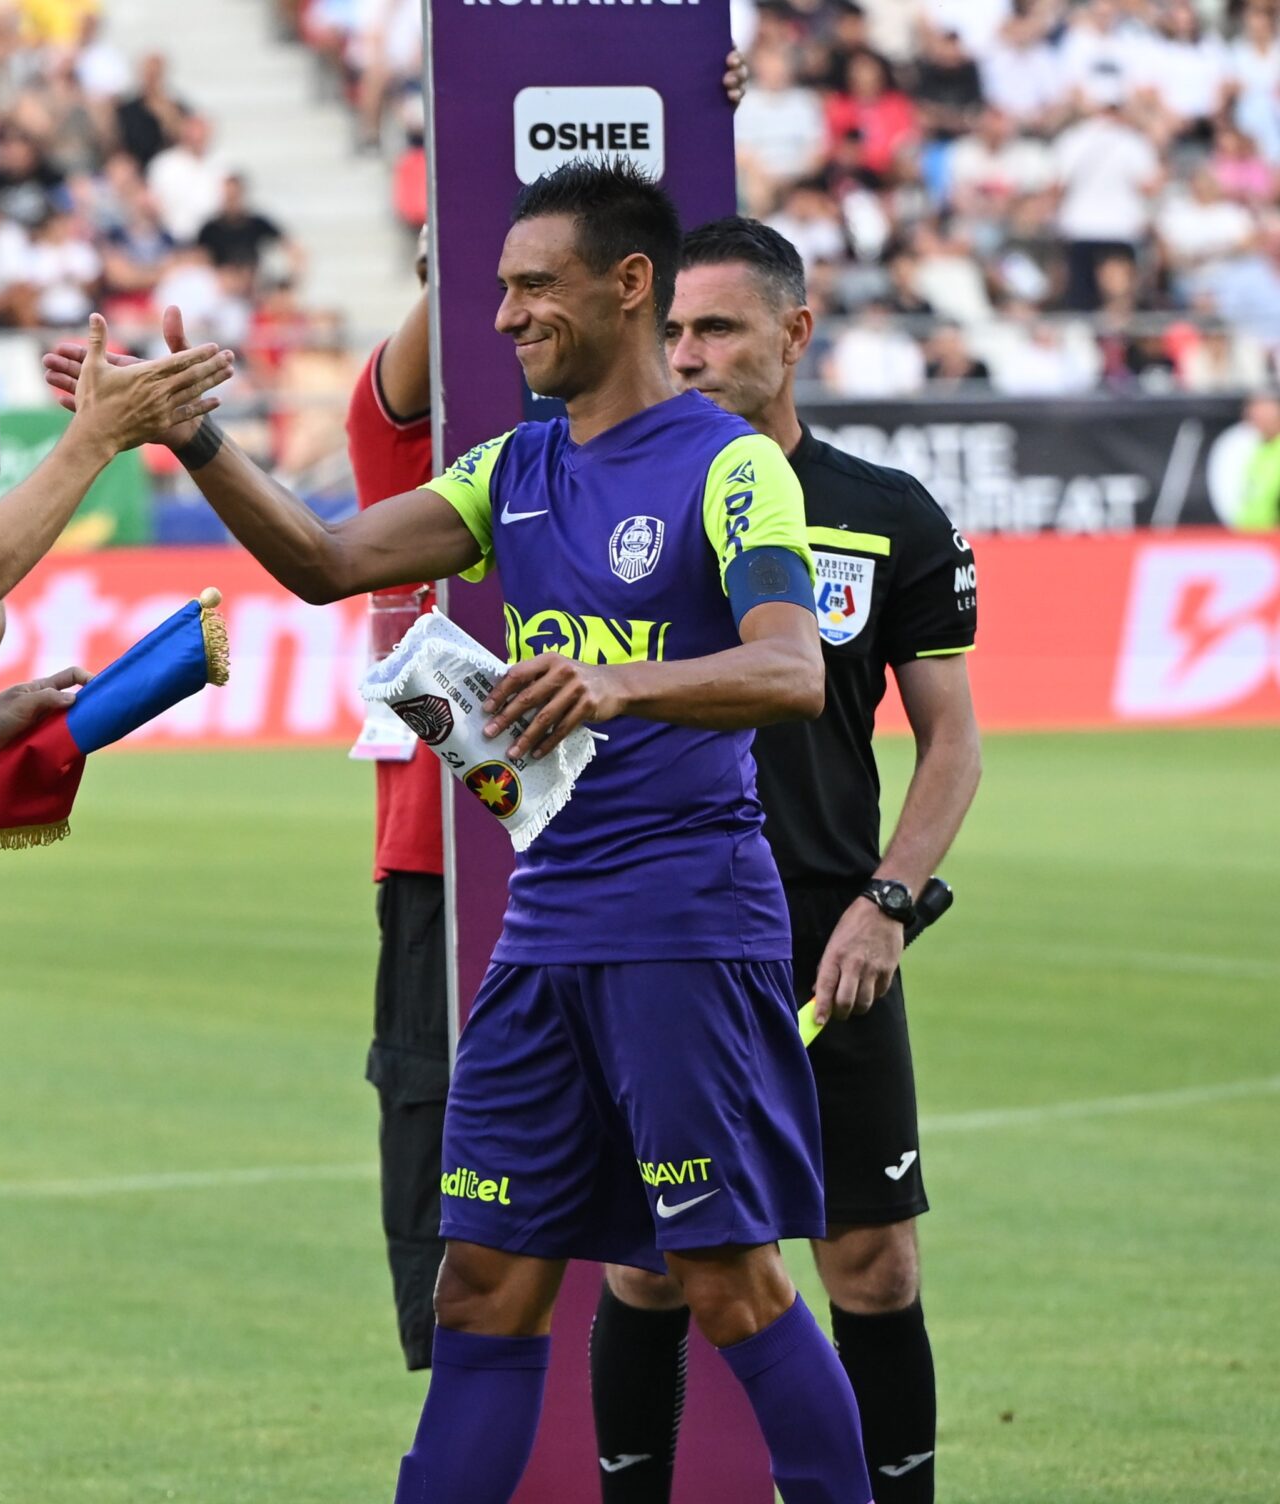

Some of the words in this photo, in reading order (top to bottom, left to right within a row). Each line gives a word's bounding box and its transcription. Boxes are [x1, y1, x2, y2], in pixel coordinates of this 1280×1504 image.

[528, 122, 650, 151] OSHEE
[817, 558, 863, 573] ARBITRU
[829, 595, 845, 609] FRF
